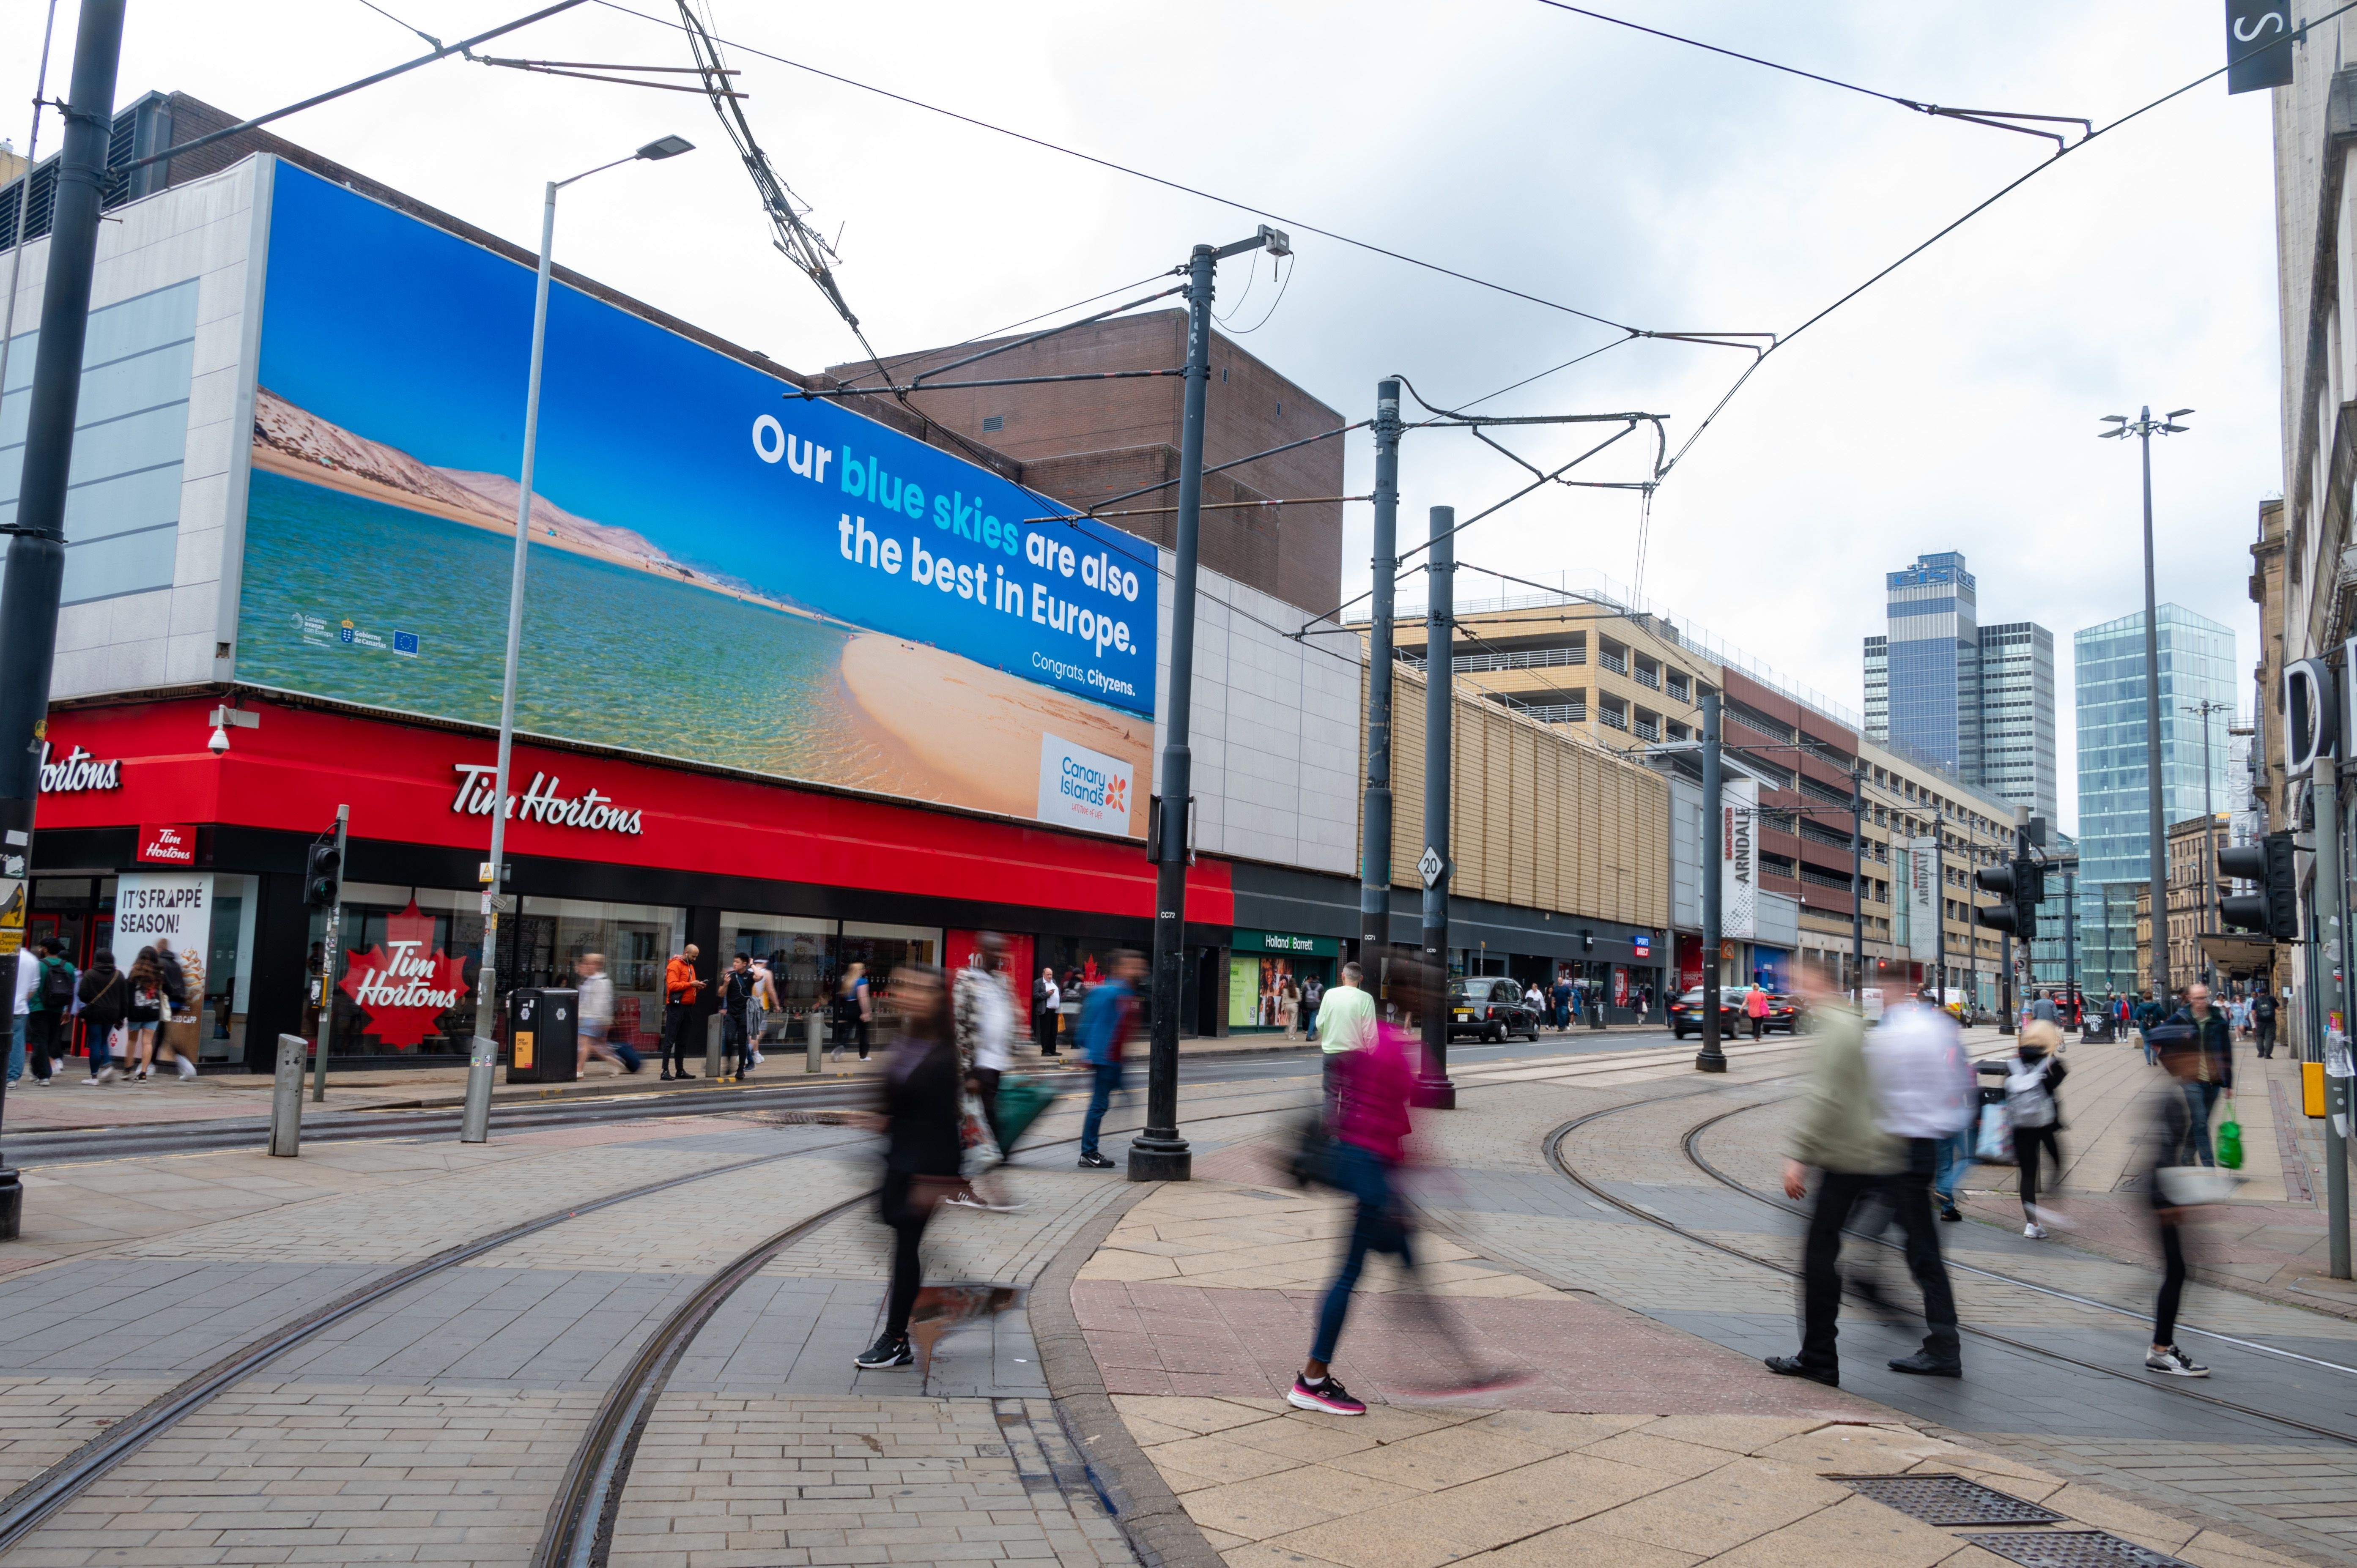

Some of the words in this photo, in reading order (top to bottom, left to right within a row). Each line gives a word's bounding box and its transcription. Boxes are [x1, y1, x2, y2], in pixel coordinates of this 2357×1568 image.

[752, 414, 832, 483] Our
[841, 445, 924, 519] blue
[933, 491, 1018, 556] skies
[1026, 532, 1075, 577] are
[1082, 552, 1138, 602] also
[839, 513, 902, 574] the
[912, 536, 987, 605] best
[995, 564, 1023, 617] in
[1032, 583, 1136, 658] Europe.
[305, 615, 327, 625] Canarias
[315, 628, 333, 638] Europa
[354, 630, 381, 641] Gobierno
[362, 639, 386, 649] Canarias
[1032, 651, 1085, 684] Congrats,
[1088, 669, 1135, 696] Cityzens.
[1063, 757, 1105, 791] Canary
[453, 764, 515, 818] Tim
[1061, 775, 1103, 806] Islands
[159, 829, 181, 844] Tim
[1735, 807, 1749, 882] ARNDALE
[146, 842, 190, 859] Hortons
[1424, 858, 1437, 874] 20
[1918, 851, 1928, 905] ARNDALE
[123, 890, 146, 909] IT'S
[149, 882, 202, 908] FRAPPÉ
[121, 914, 180, 933] SEASON!
[1266, 935, 1289, 949] Holland
[1293, 937, 1313, 950] Barrett
[1636, 947, 1649, 956] DIRECT
[1637, 937, 1649, 946] SPORTS
[387, 941, 436, 978] Tim
[355, 968, 457, 1008] Hortons
